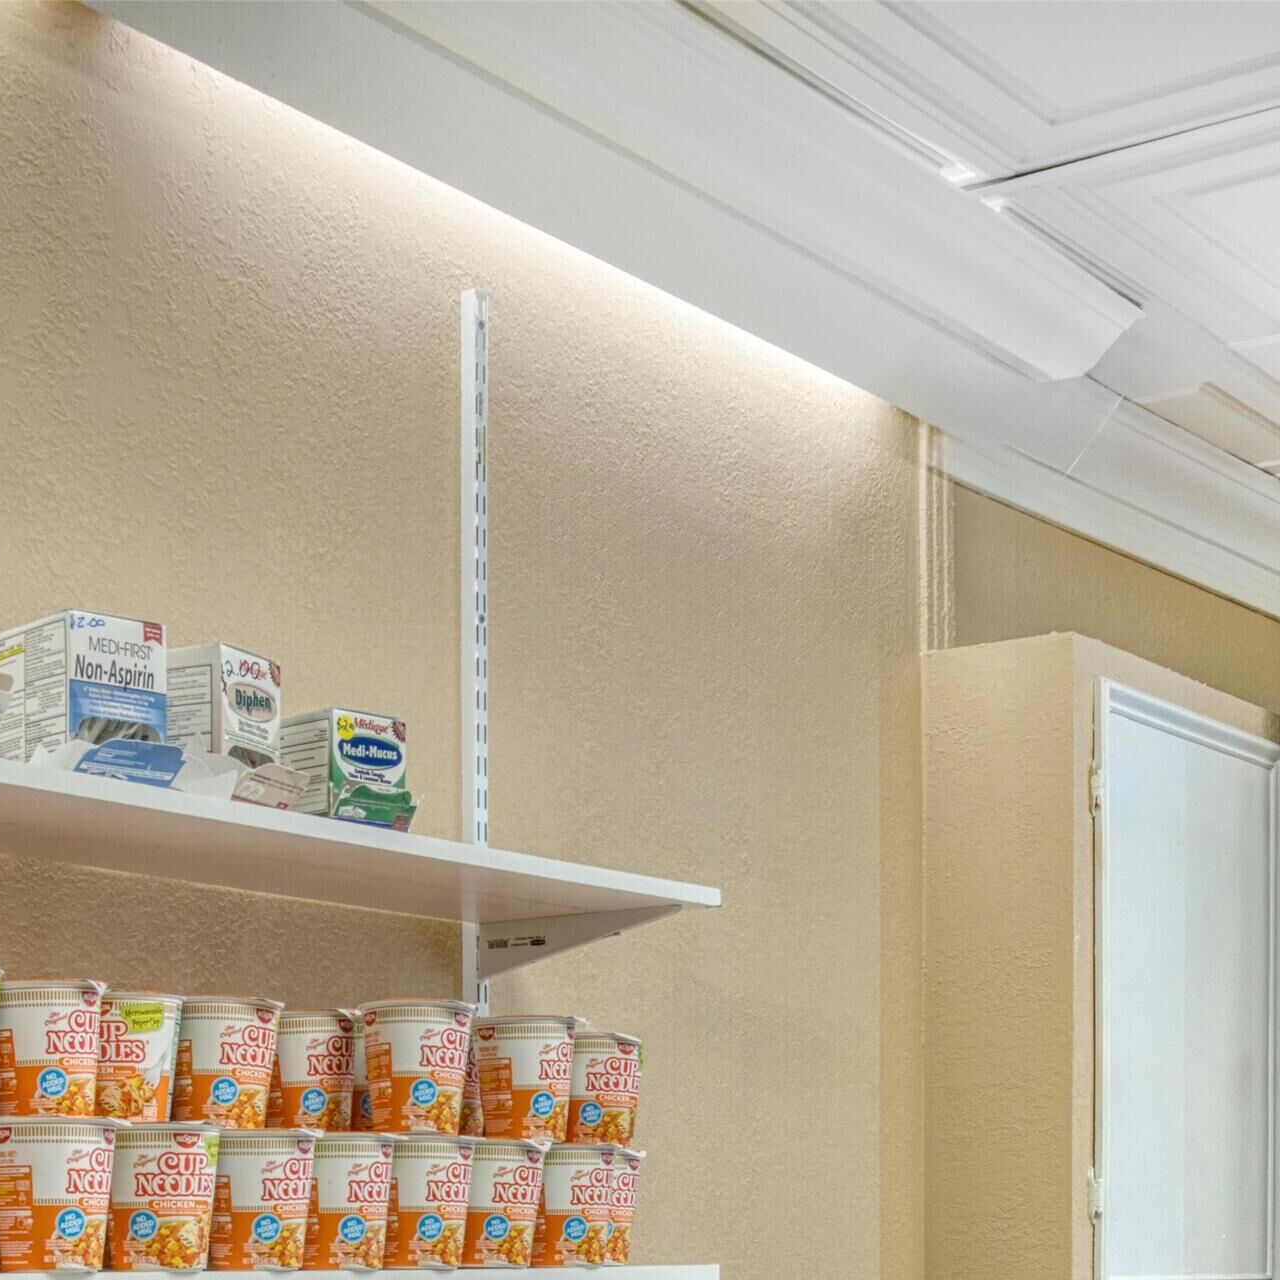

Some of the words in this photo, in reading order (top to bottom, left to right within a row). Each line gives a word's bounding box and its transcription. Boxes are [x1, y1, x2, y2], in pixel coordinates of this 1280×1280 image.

[89, 636, 152, 660] MEDI-FIRST
[75, 654, 154, 692] Non-Aspirin
[235, 688, 272, 716] Diphen
[157, 1152, 208, 1174] CUP
